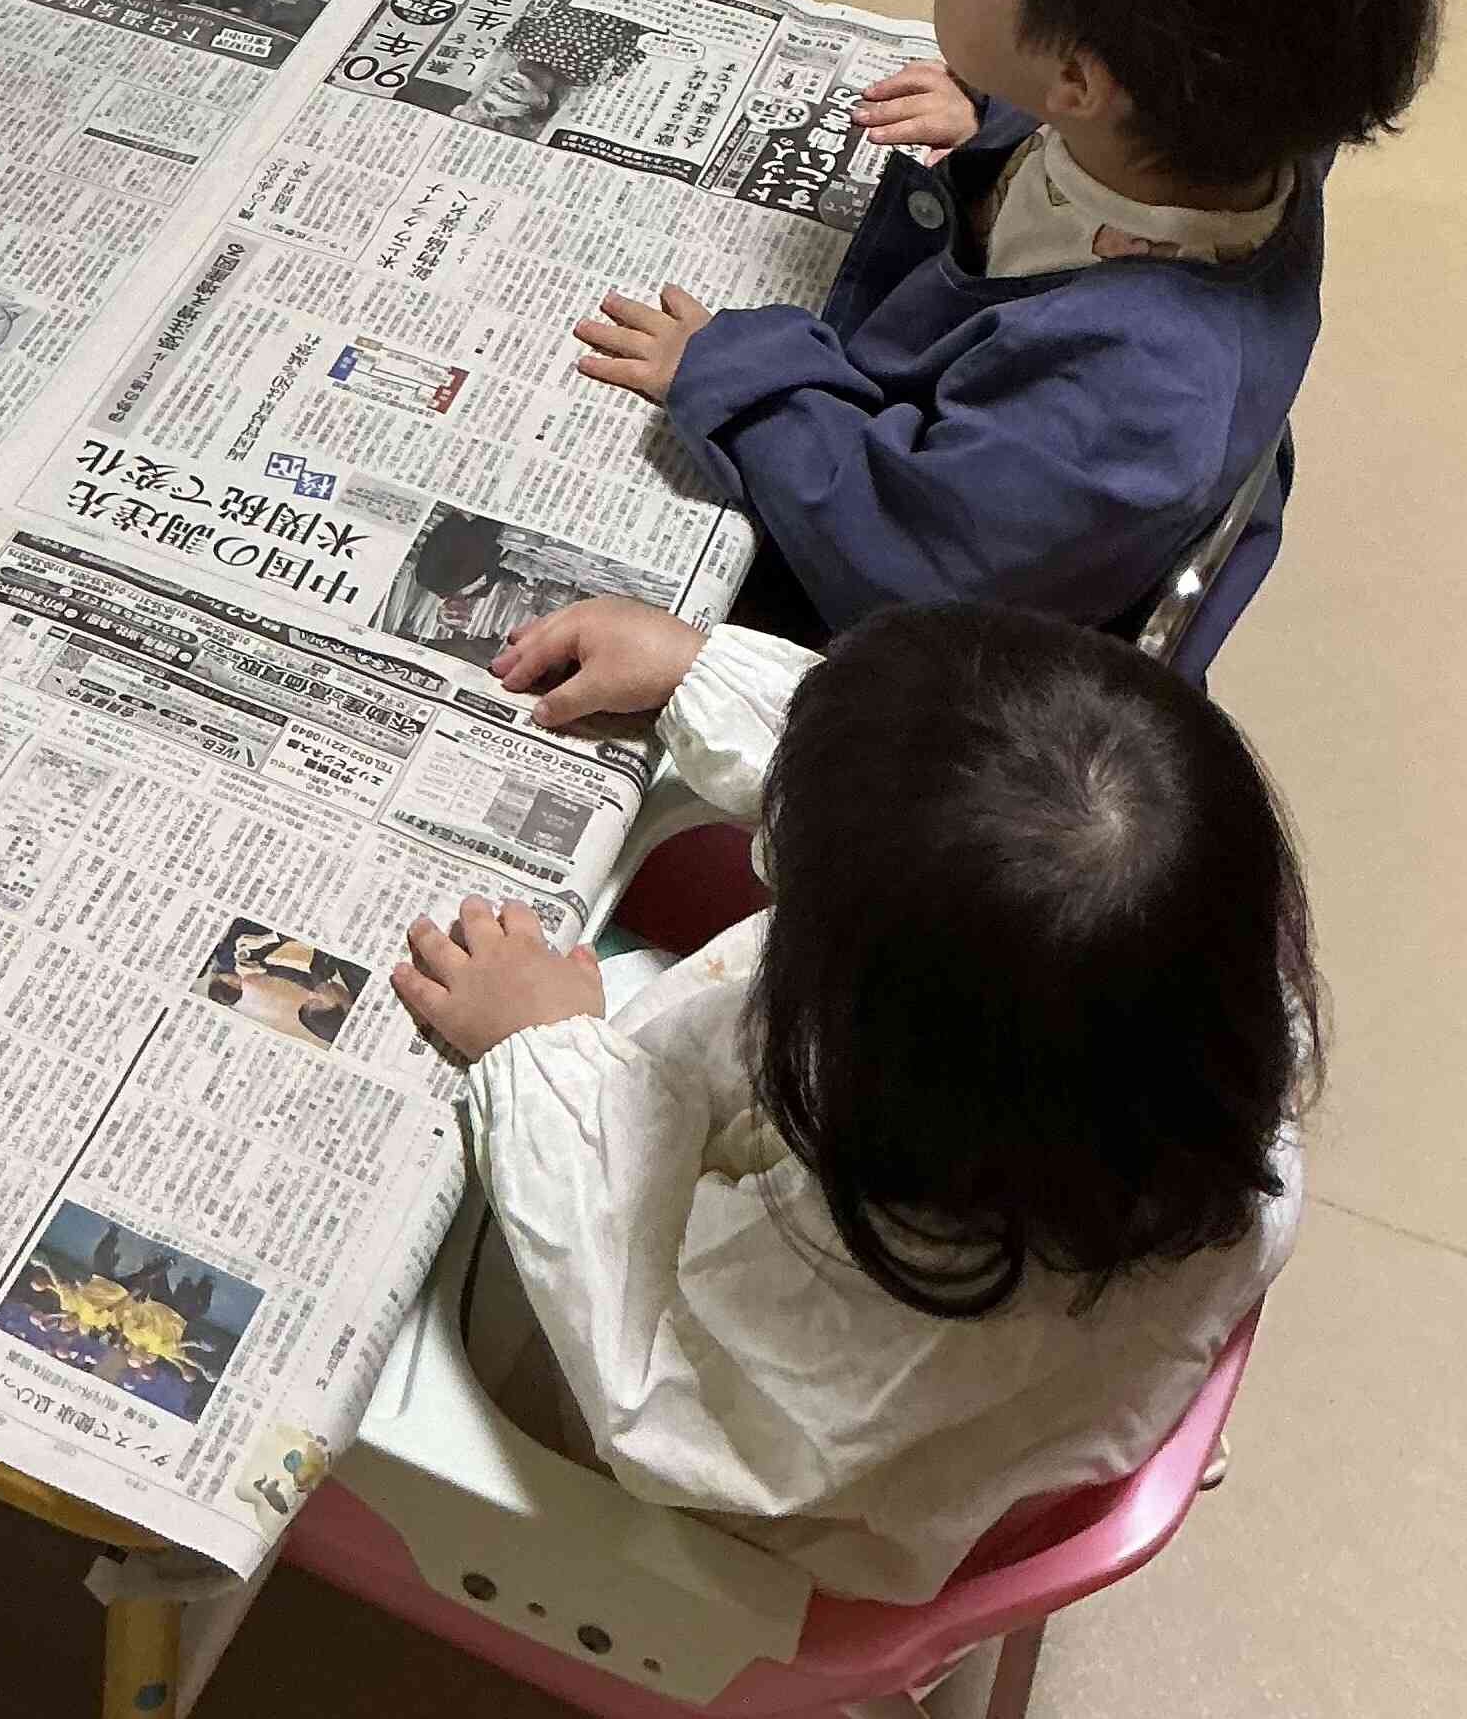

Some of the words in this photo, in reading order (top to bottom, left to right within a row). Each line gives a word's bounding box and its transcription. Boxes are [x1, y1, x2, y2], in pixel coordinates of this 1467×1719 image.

[423, 28, 474, 75] 無理を
[454, 33, 498, 76] しない
[746, 135, 799, 201] ドイツ人の
[776, 85, 860, 213] すごい働き方
[374, 180, 446, 271] 米とウクライナ
[406, 189, 479, 281] 鉱物協定署名へ
[68, 436, 371, 562] 米関税で変化
[264, 452, 337, 498] 核心
[58, 478, 365, 609] 中国の調達先
[303, 757, 355, 783] 中日新聞
